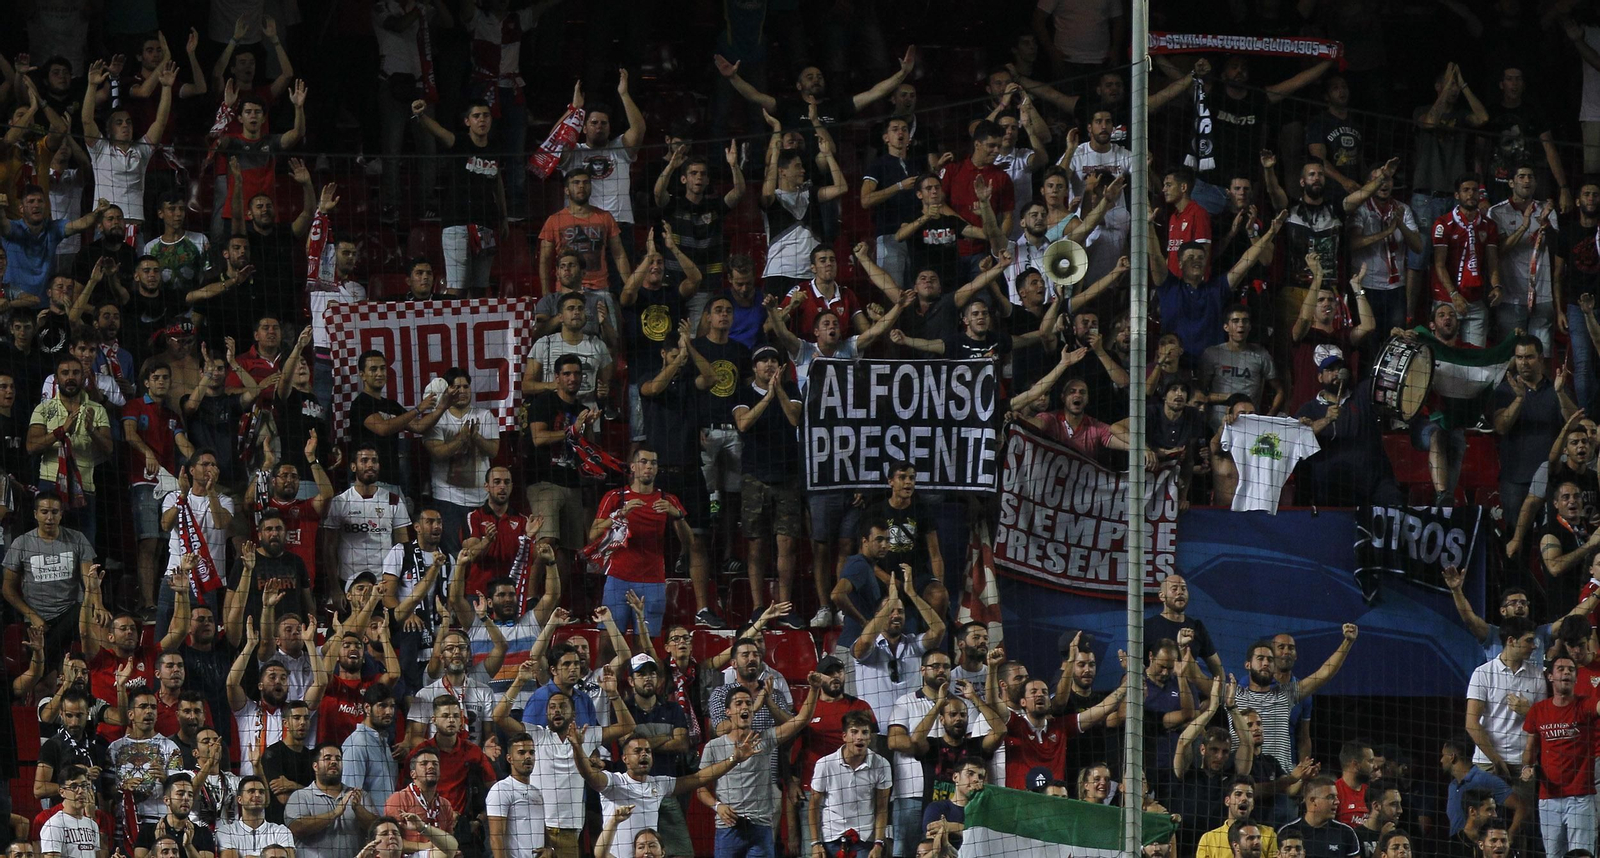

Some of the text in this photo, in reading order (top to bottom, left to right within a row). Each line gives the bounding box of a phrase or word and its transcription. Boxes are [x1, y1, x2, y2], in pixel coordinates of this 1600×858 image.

[1217, 35, 1261, 51] FUTBOL
[1262, 38, 1292, 53] CLUB
[1293, 41, 1320, 56] 1905
[1221, 366, 1251, 379] FILA
[812, 425, 997, 485] PRESENTE
